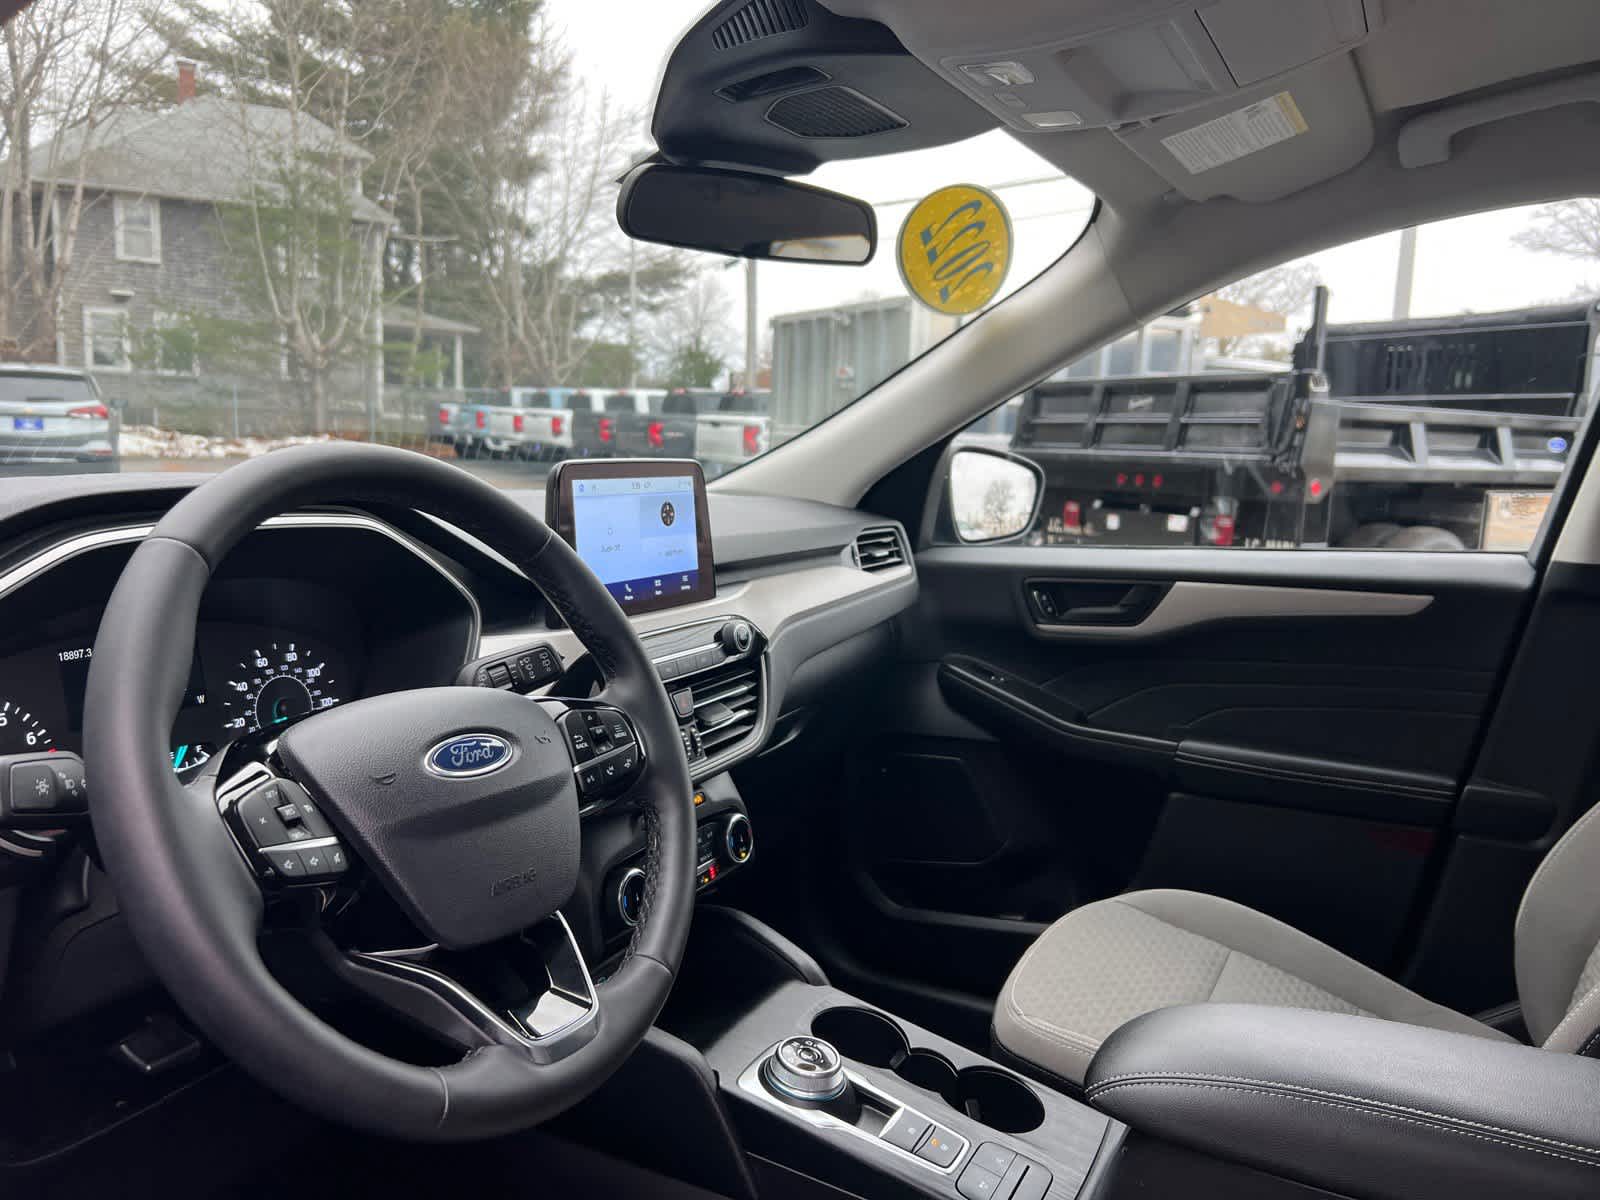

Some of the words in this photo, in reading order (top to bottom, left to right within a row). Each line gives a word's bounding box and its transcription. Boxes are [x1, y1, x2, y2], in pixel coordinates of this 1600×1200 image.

[59, 648, 92, 662] 18897.3
[286, 652, 298, 662] 80
[256, 657, 268, 668] 60
[307, 667, 321, 678] 100
[236, 681, 248, 692] 40
[233, 717, 246, 729] 20
[26, 731, 37, 746] 6
[450, 740, 495, 767] Ford
